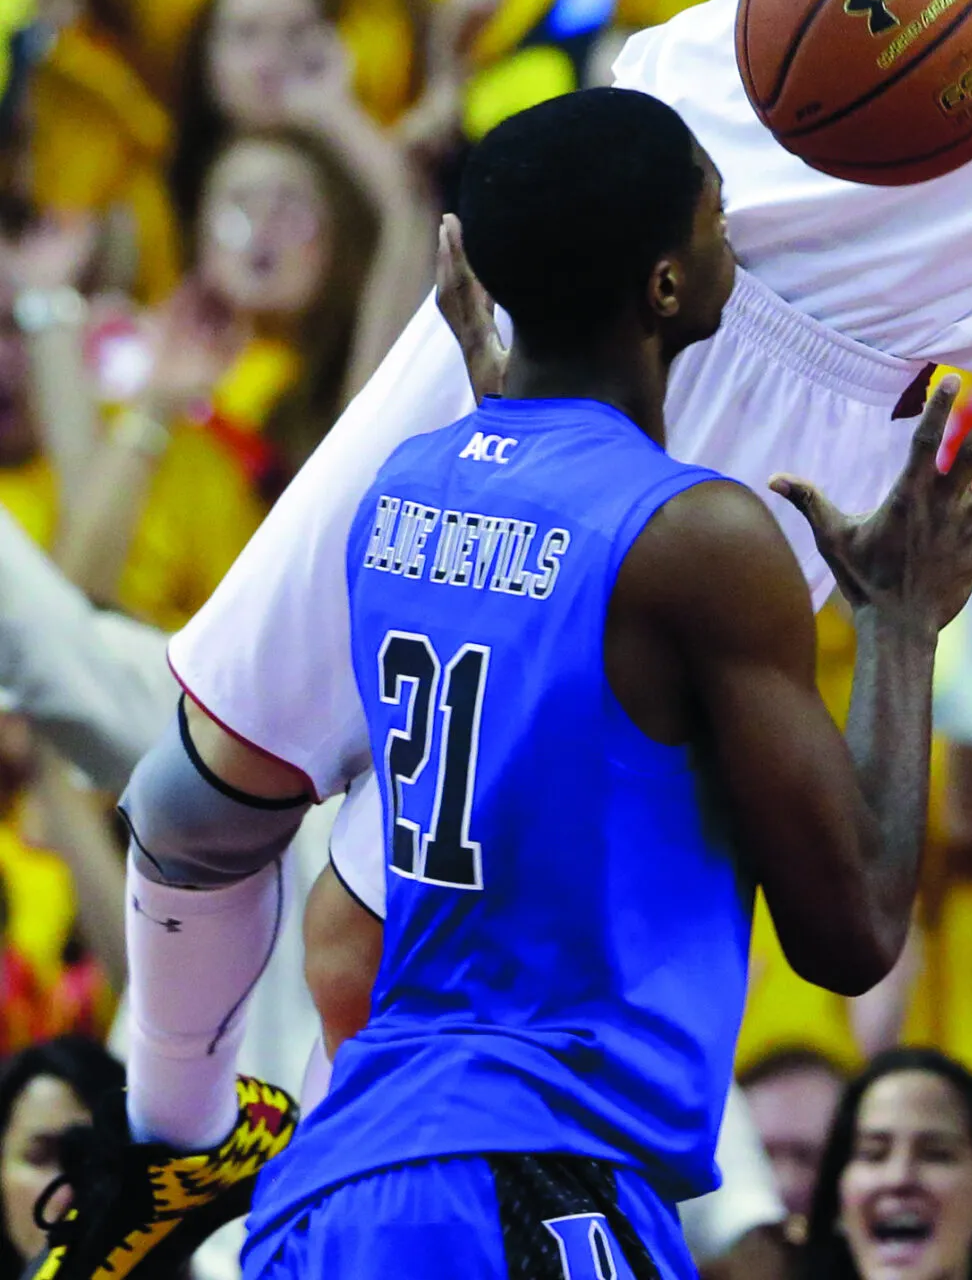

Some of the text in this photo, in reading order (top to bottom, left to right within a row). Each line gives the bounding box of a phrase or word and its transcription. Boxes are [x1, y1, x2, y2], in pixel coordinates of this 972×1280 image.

[458, 431, 519, 465] ACC
[429, 509, 571, 601] DEVILS
[377, 629, 492, 891] 21
